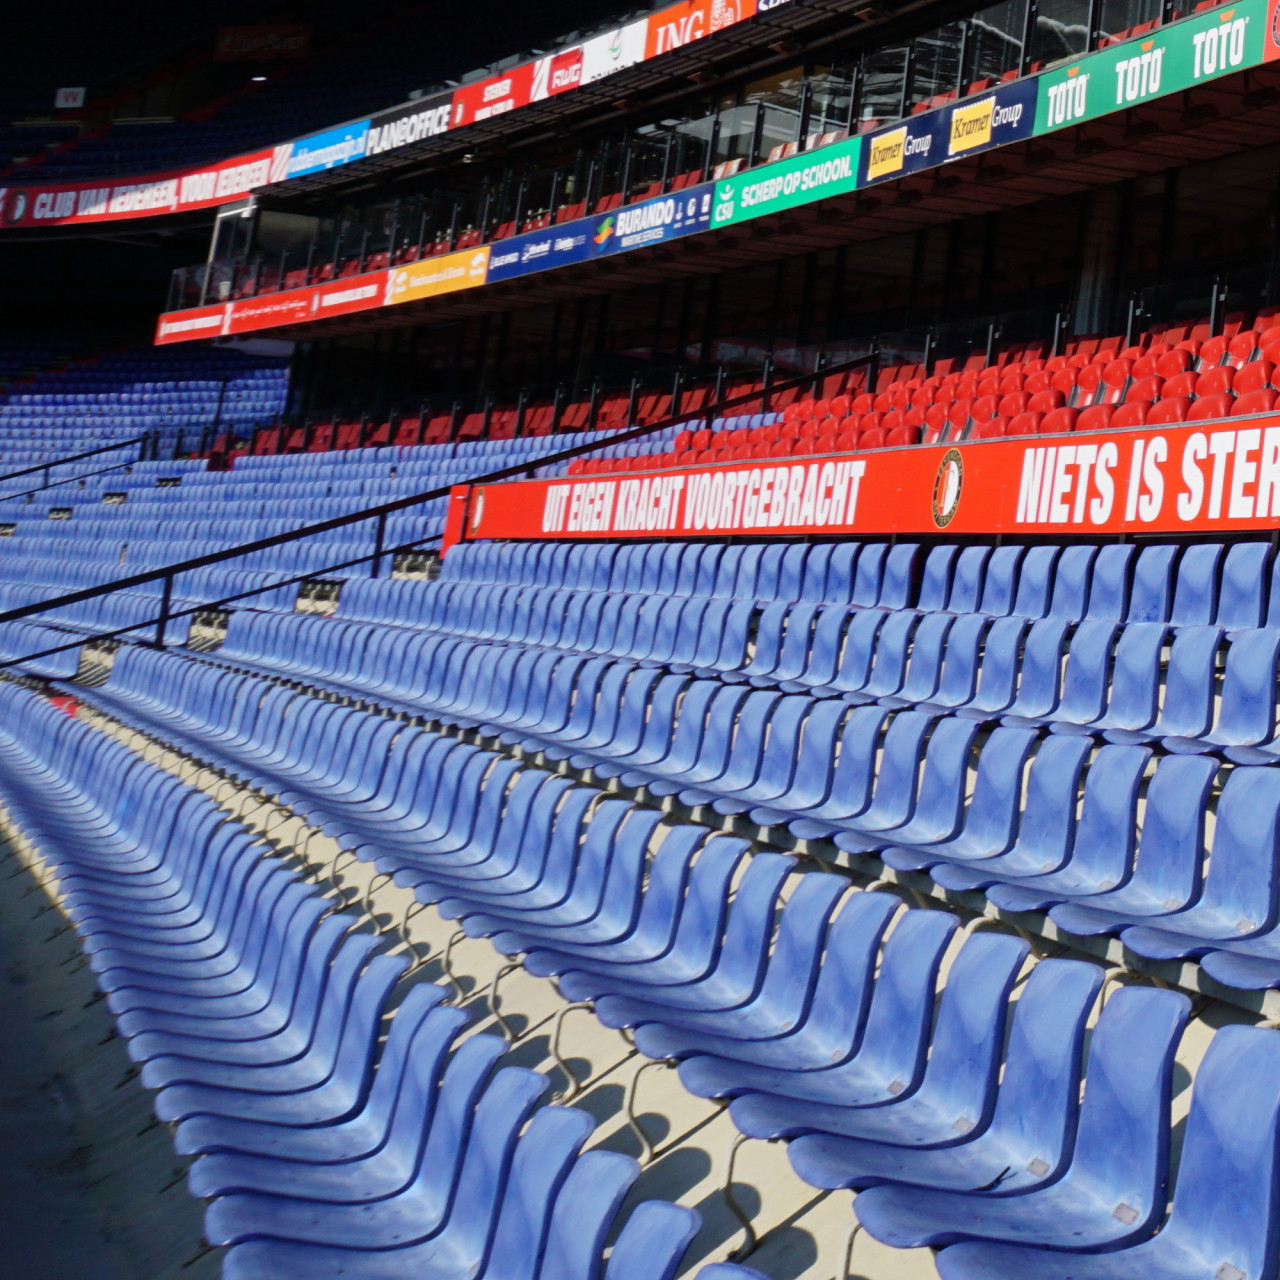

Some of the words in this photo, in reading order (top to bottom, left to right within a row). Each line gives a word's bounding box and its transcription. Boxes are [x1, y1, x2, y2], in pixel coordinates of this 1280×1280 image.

[656, 9, 705, 56] ING
[1193, 19, 1243, 78] TOTO
[1047, 74, 1086, 127] TOTO
[1115, 51, 1162, 104] TOTO
[954, 111, 991, 140] Kramer
[992, 101, 1023, 128] Group
[871, 138, 903, 167] Kramer
[904, 132, 932, 158] Group
[715, 201, 735, 222] CSU
[740, 184, 783, 208] SCHERP
[784, 173, 801, 196] OP
[615, 198, 675, 236] BURANDO
[542, 484, 570, 532] UIT
[568, 480, 617, 531] EIGEN
[617, 475, 685, 530] KRACHT
[684, 460, 867, 529] VOORTGEBRACHT
[1016, 441, 1119, 524] NIETS
[1124, 436, 1174, 523] IS
